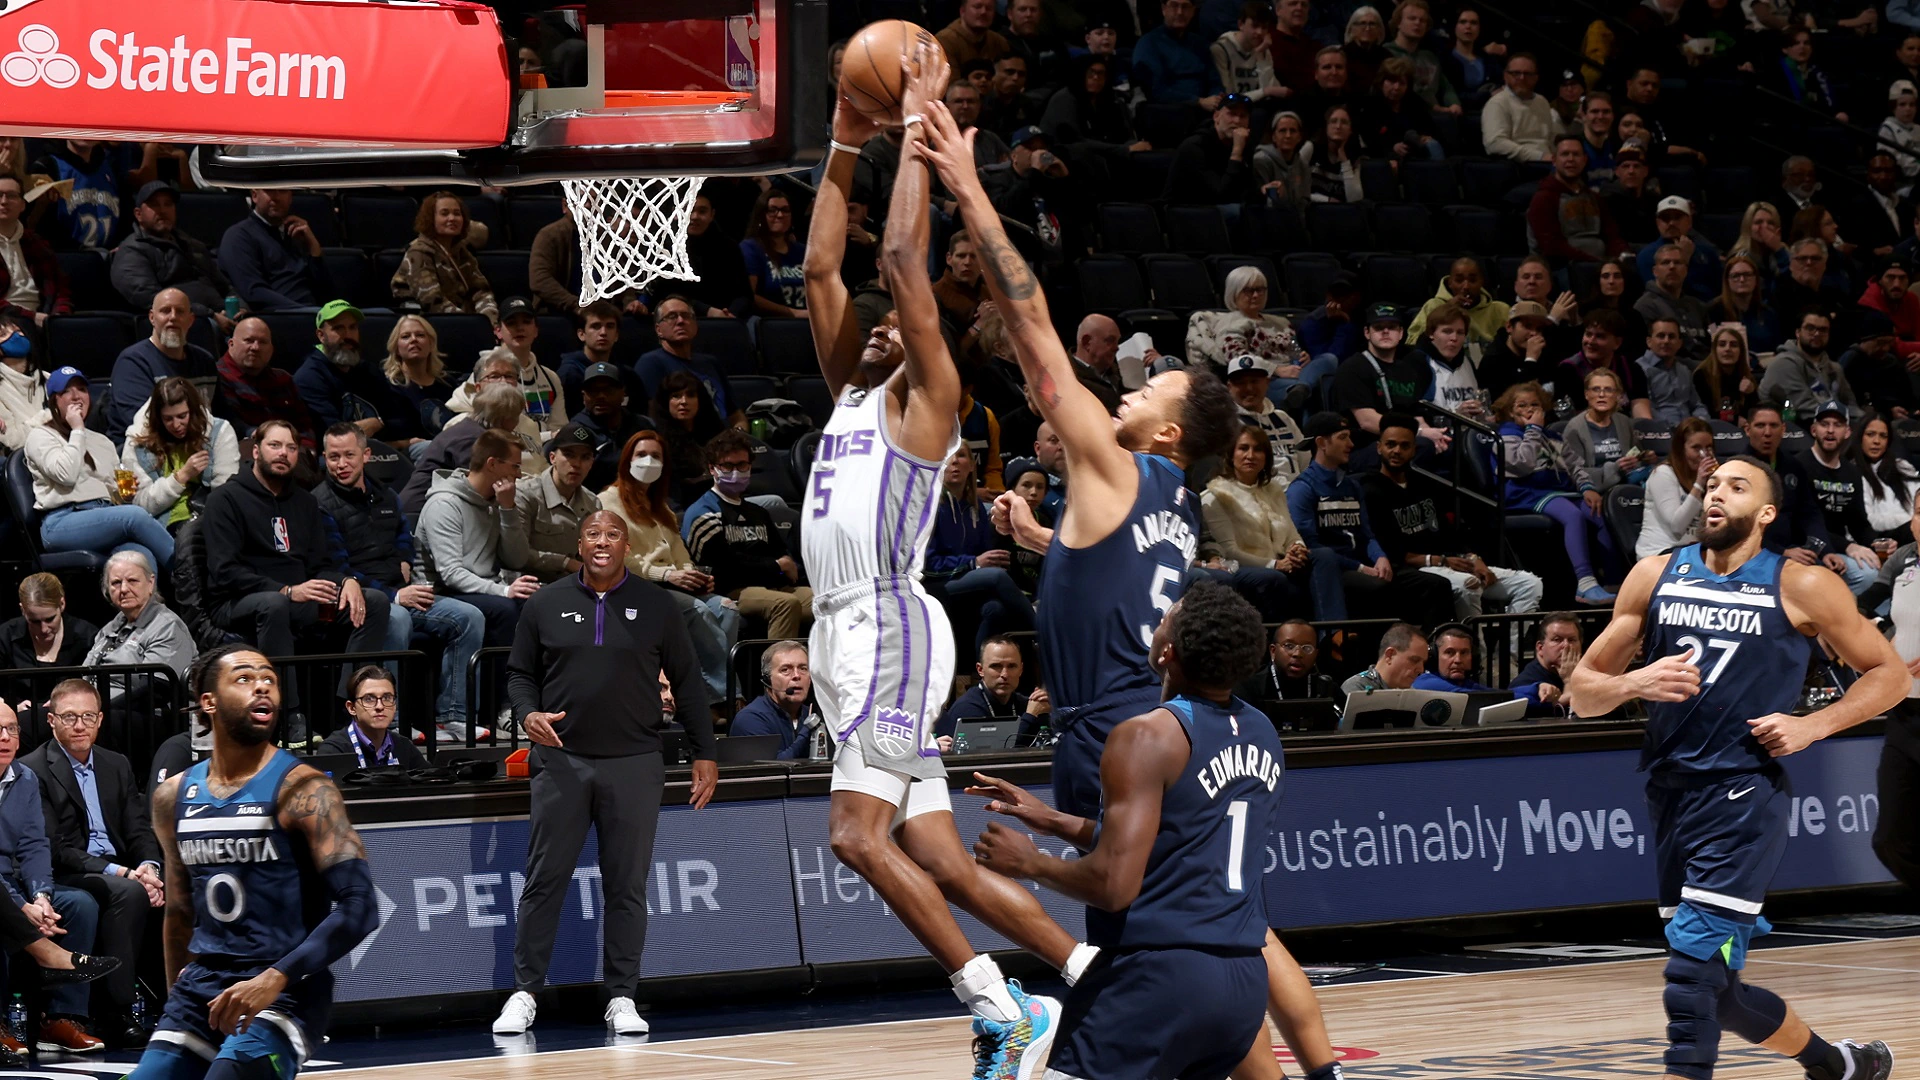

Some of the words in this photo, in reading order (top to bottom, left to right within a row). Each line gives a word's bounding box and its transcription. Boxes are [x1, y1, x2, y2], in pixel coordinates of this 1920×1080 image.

[730, 63, 748, 82] NBA
[79, 213, 112, 248] 21
[367, 453, 399, 463] EXUS
[814, 429, 876, 463] NGS
[813, 468, 836, 520] 5
[1318, 512, 1361, 528] MINNESOT
[1677, 563, 1691, 575] 6
[1140, 562, 1181, 650] 5
[1658, 602, 1762, 636] MINNESOTA
[1675, 635, 1741, 685] 27
[875, 722, 914, 742] SAC
[1197, 744, 1281, 800] EDWARDS
[185, 784, 198, 799] 6
[1519, 798, 1645, 856] Move,
[1836, 793, 1880, 834] an
[177, 836, 279, 866] MINNESOTA
[1226, 800, 1249, 891] 1
[206, 872, 245, 923] 0
[413, 859, 721, 932] PETIR
